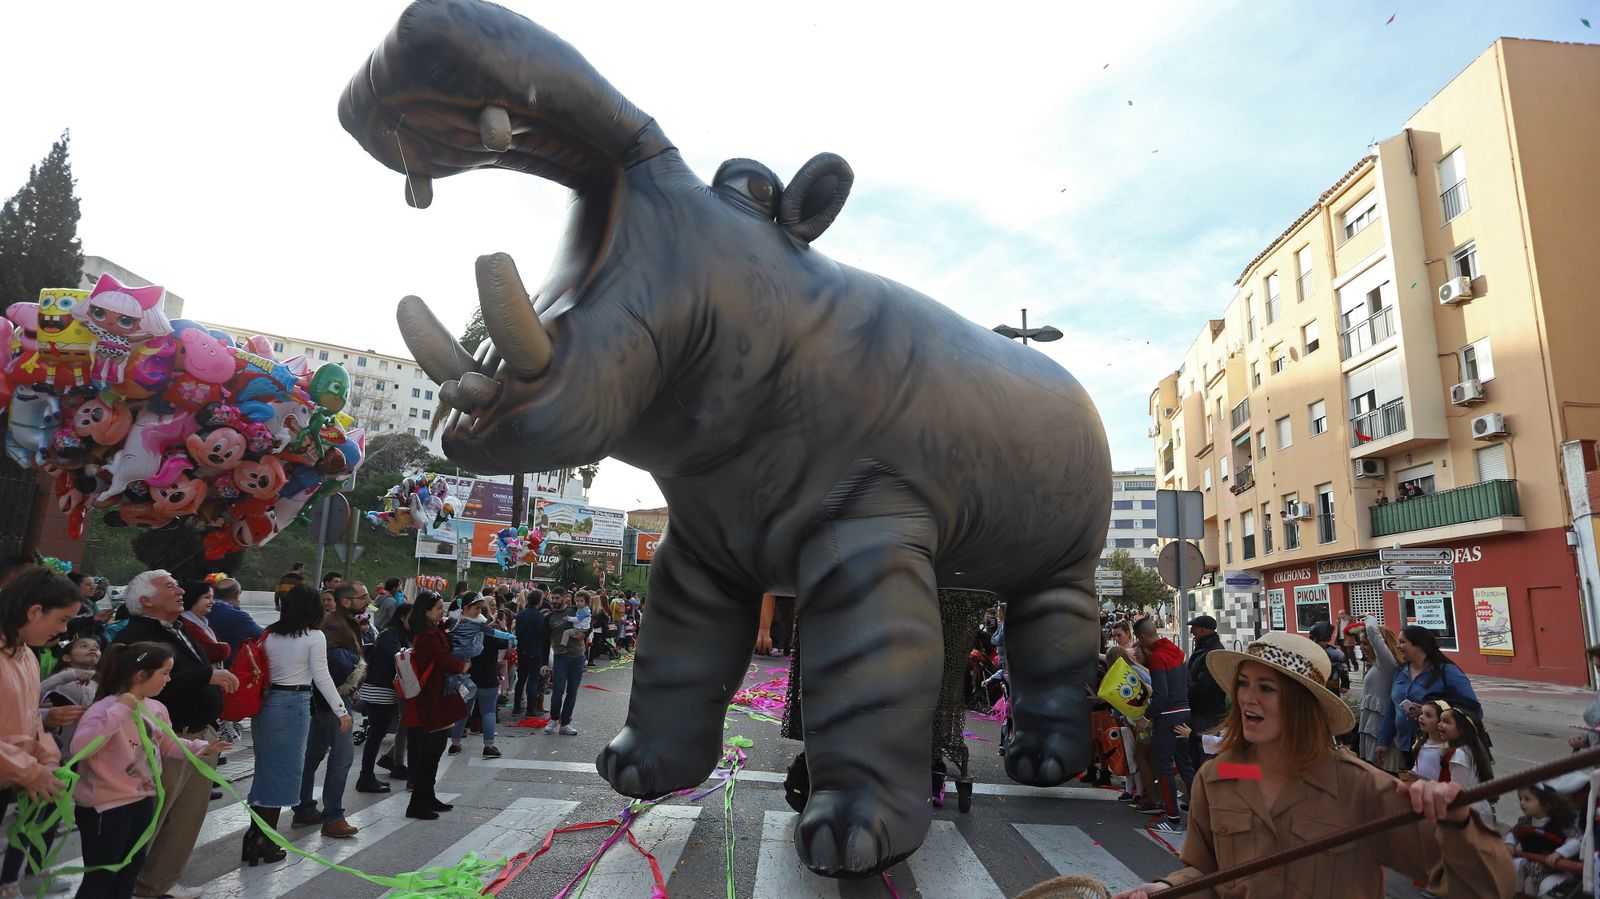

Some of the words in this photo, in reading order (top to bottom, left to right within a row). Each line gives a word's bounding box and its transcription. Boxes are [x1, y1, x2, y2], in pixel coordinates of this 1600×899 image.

[1273, 568, 1311, 583] COLCHONES
[1269, 593, 1284, 604] FLEX
[1297, 589, 1327, 602] PIKOLIN
